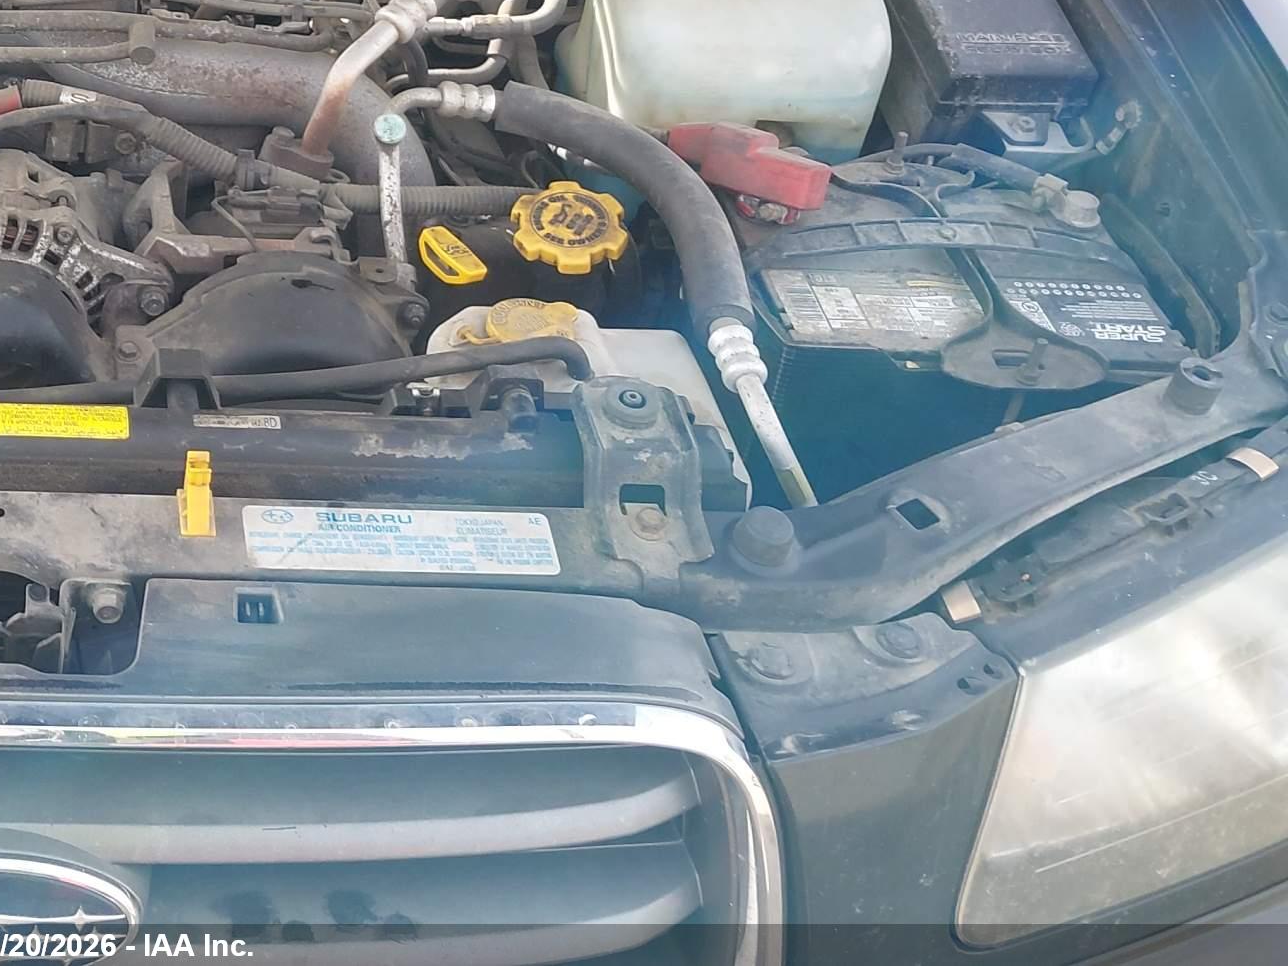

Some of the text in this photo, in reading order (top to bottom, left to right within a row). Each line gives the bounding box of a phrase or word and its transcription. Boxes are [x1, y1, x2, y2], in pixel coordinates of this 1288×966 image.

[544, 232, 565, 245] SEE
[1091, 323, 1167, 337] START
[1094, 331, 1164, 343] SUPER
[315, 511, 413, 524] SUBARU
